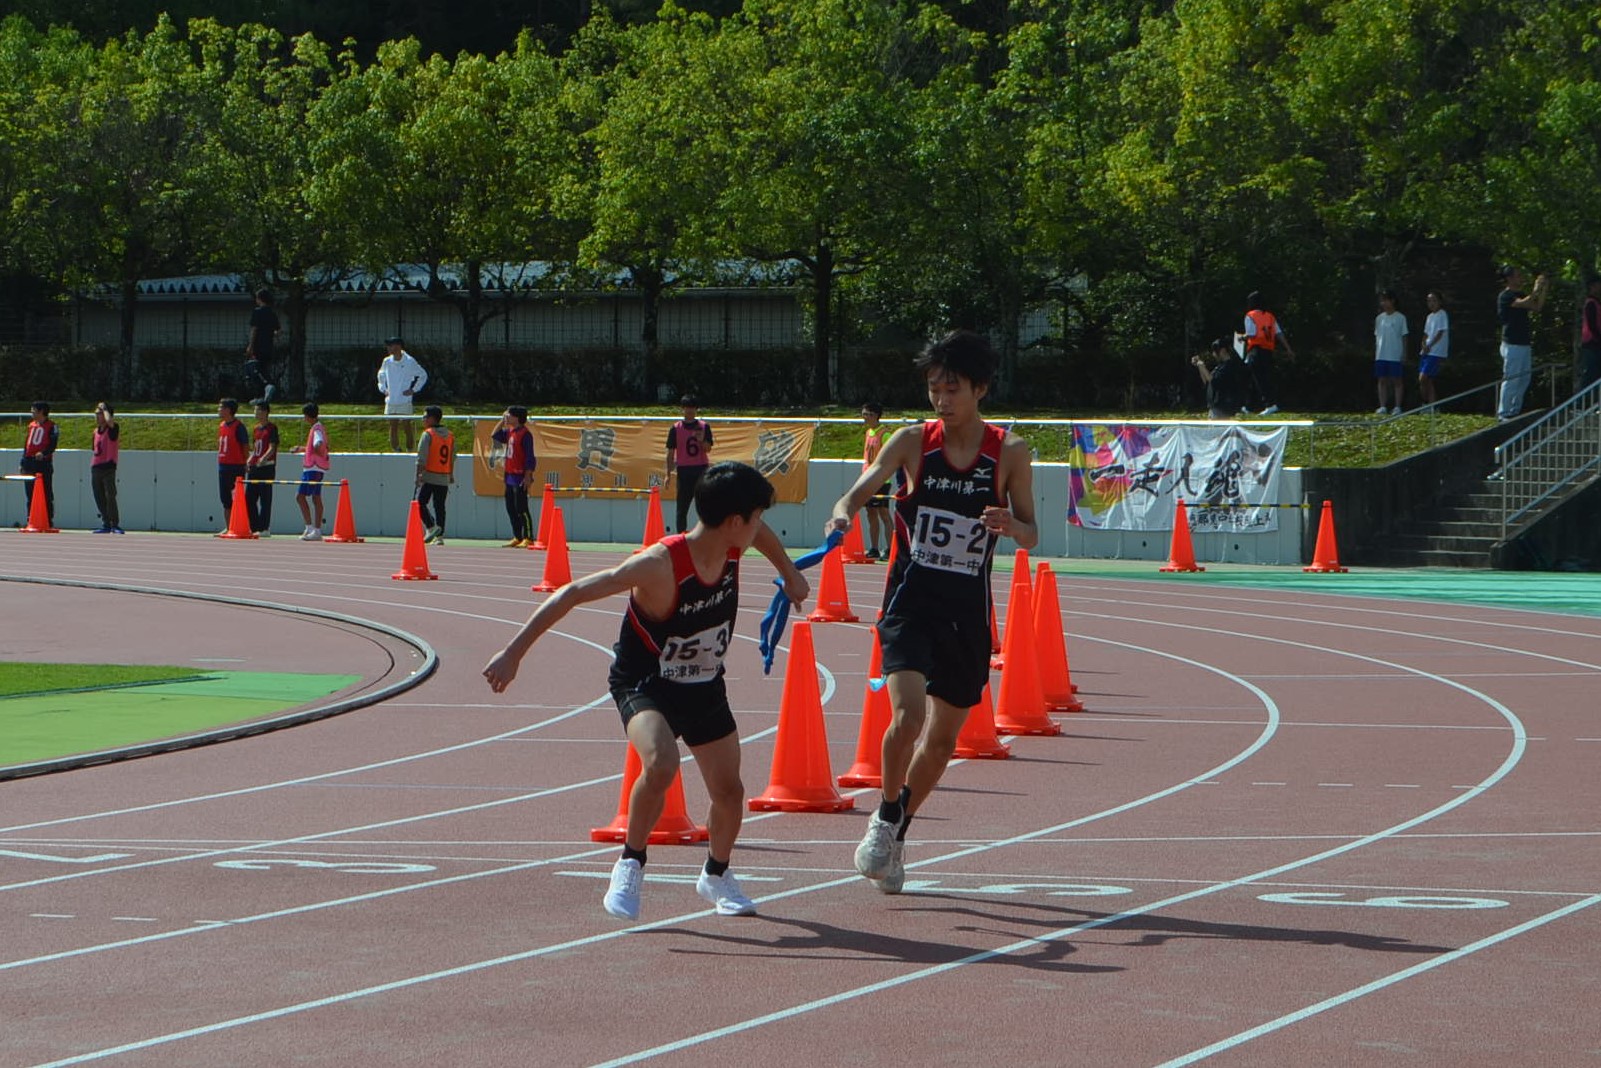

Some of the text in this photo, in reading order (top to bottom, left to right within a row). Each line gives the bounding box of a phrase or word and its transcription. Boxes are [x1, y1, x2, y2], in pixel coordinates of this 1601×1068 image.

[27, 427, 45, 446] 10
[686, 436, 699, 457] 6
[440, 444, 449, 465] 9
[923, 475, 990, 496] 中津川第一
[918, 512, 987, 555] 15-2
[912, 548, 981, 573] 中津第一中
[680, 588, 733, 616] 中津川第一
[664, 627, 729, 662] 15-3
[213, 859, 437, 874] 3
[902, 880, 1134, 897] 5
[1256, 892, 1511, 909] 6
